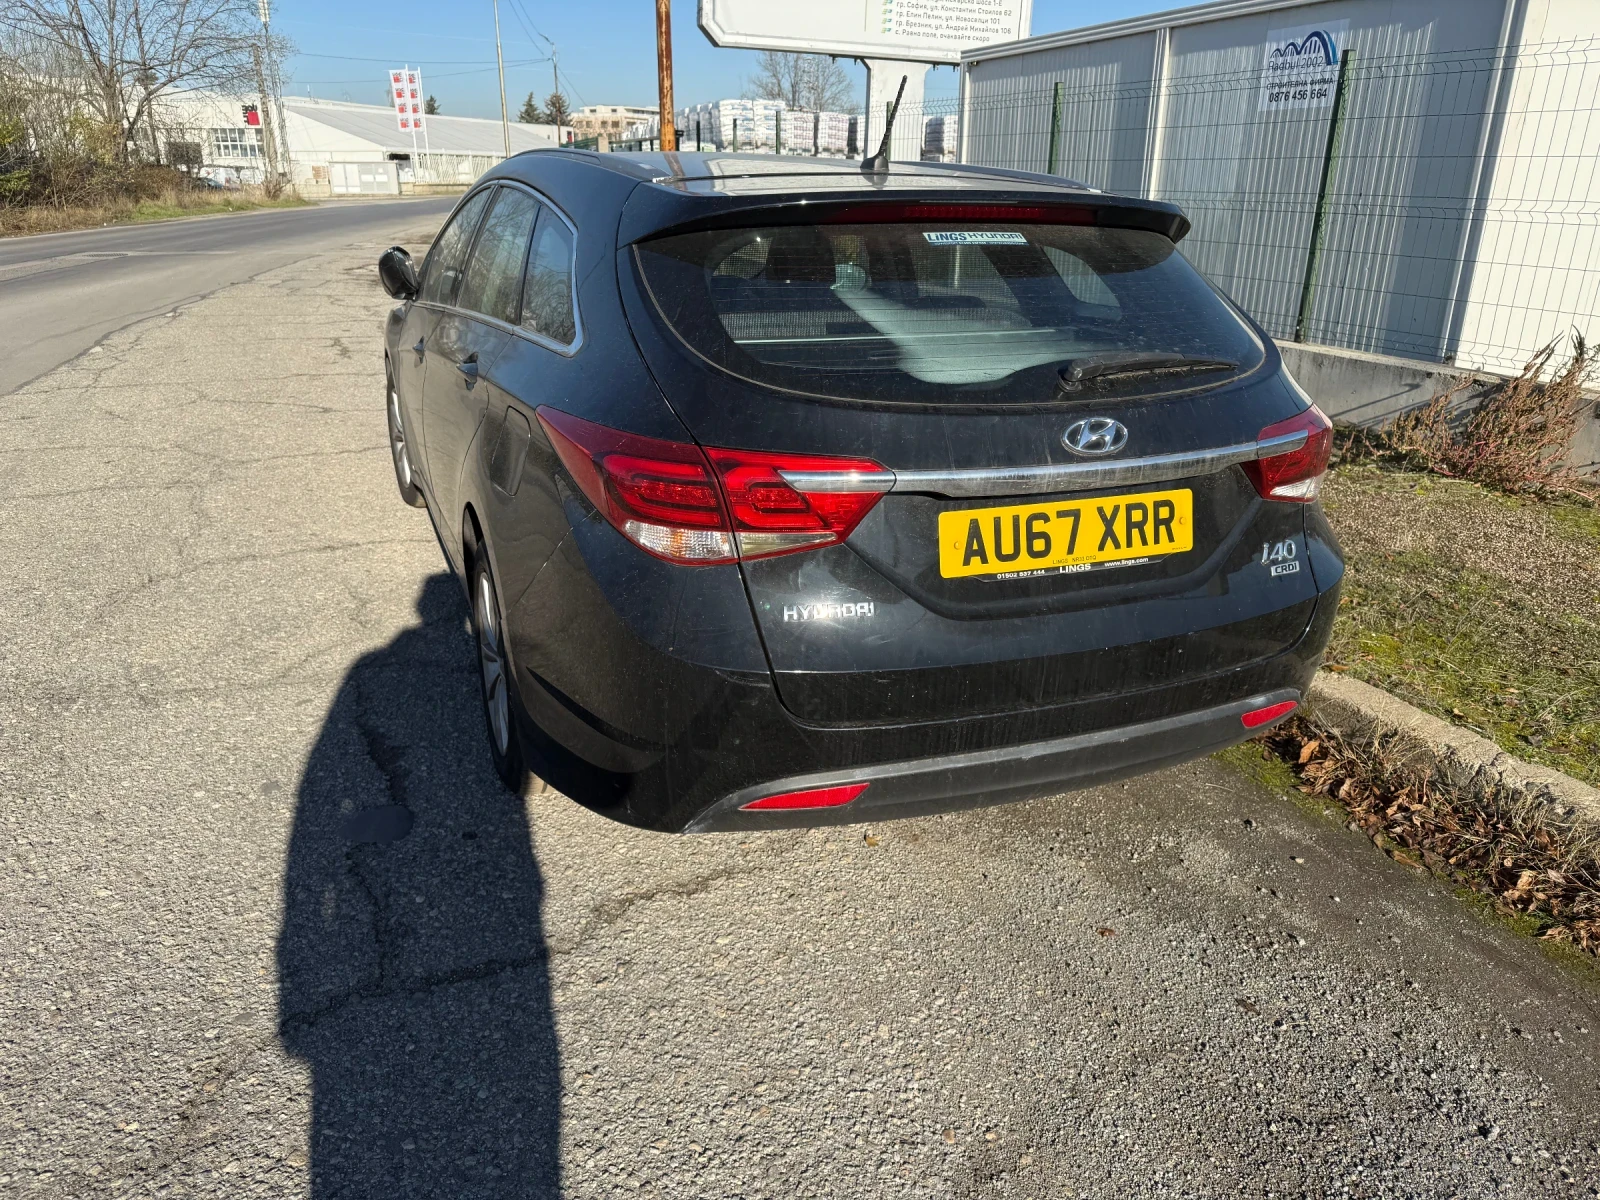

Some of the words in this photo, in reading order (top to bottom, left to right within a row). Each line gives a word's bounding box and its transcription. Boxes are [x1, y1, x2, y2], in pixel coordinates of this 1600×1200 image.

[1003, 9, 1012, 17] 62
[990, 17, 1000, 25] 101
[902, 28, 921, 37] Равно
[940, 33, 971, 41] очаквайте
[972, 35, 990, 43] скоро
[945, 23, 968, 32] Андрей
[1001, 27, 1012, 35] 106
[1300, 55, 1324, 69] 2002
[1269, 91, 1290, 103] 0876
[1292, 89, 1308, 100] 456
[1310, 87, 1328, 99] 664
[967, 232, 1023, 240] HYUNDAI
[962, 508, 1082, 567] AU67
[1096, 498, 1176, 552] XRR
[1261, 539, 1296, 565] i40
[996, 572, 1018, 580] 01502
[1059, 563, 1091, 574] LINGS
[1104, 556, 1149, 568] www.lings.com
[783, 602, 875, 622] HYUNDAI
